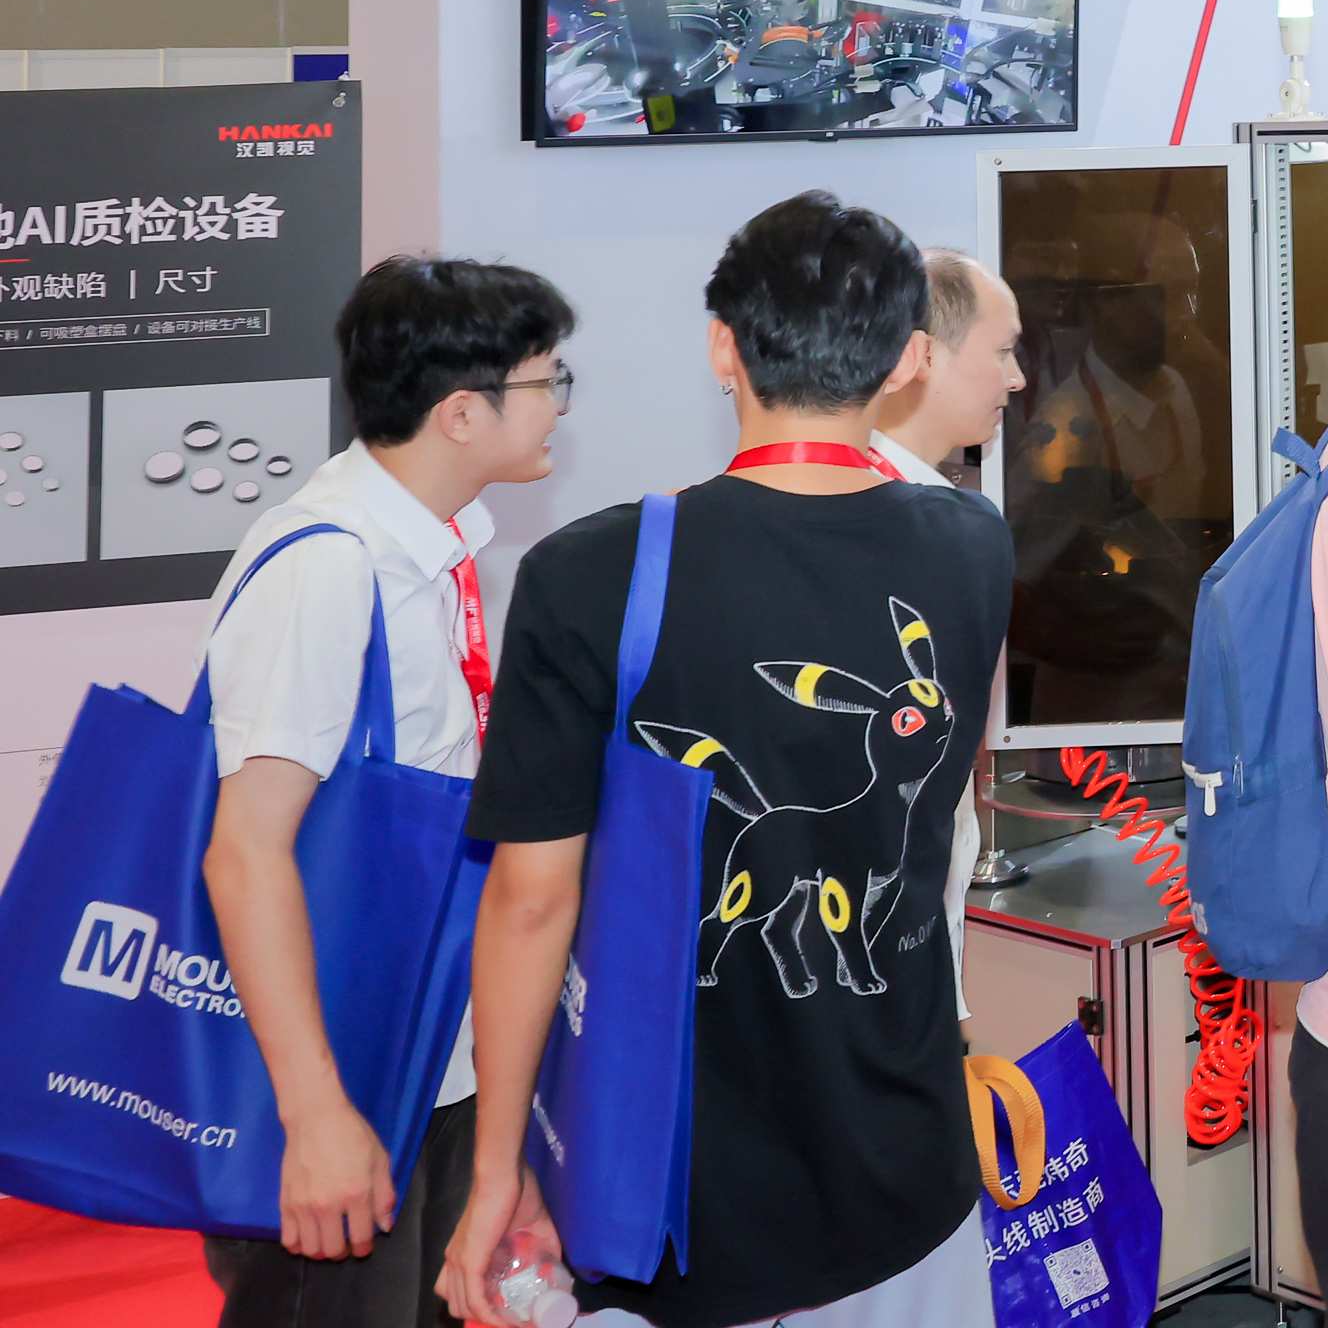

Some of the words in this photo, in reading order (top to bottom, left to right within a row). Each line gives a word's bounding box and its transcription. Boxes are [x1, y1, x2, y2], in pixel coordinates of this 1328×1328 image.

[218, 123, 333, 141] HANKAI
[236, 141, 315, 158] 汉凯视觉
[155, 266, 218, 295] 尺寸
[154, 943, 238, 994] MOU
[150, 975, 246, 1019] ELECTRO
[48, 1072, 237, 1149] www.mouser.cn
